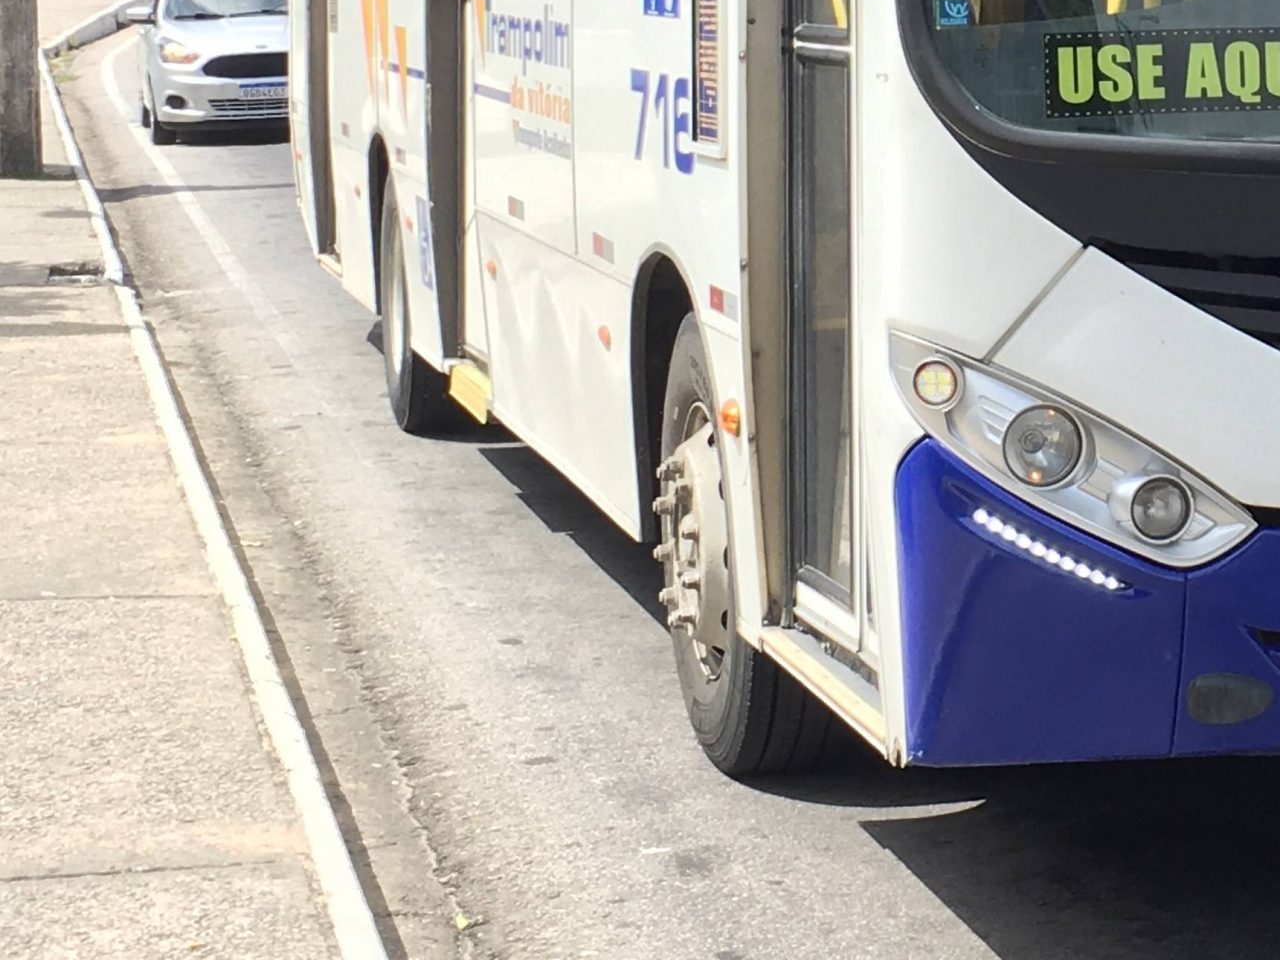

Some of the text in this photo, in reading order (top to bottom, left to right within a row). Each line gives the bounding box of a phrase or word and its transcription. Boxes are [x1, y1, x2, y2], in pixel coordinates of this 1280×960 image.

[511, 75, 525, 110] da
[1057, 44, 1166, 104] USE
[630, 67, 694, 174] 716
